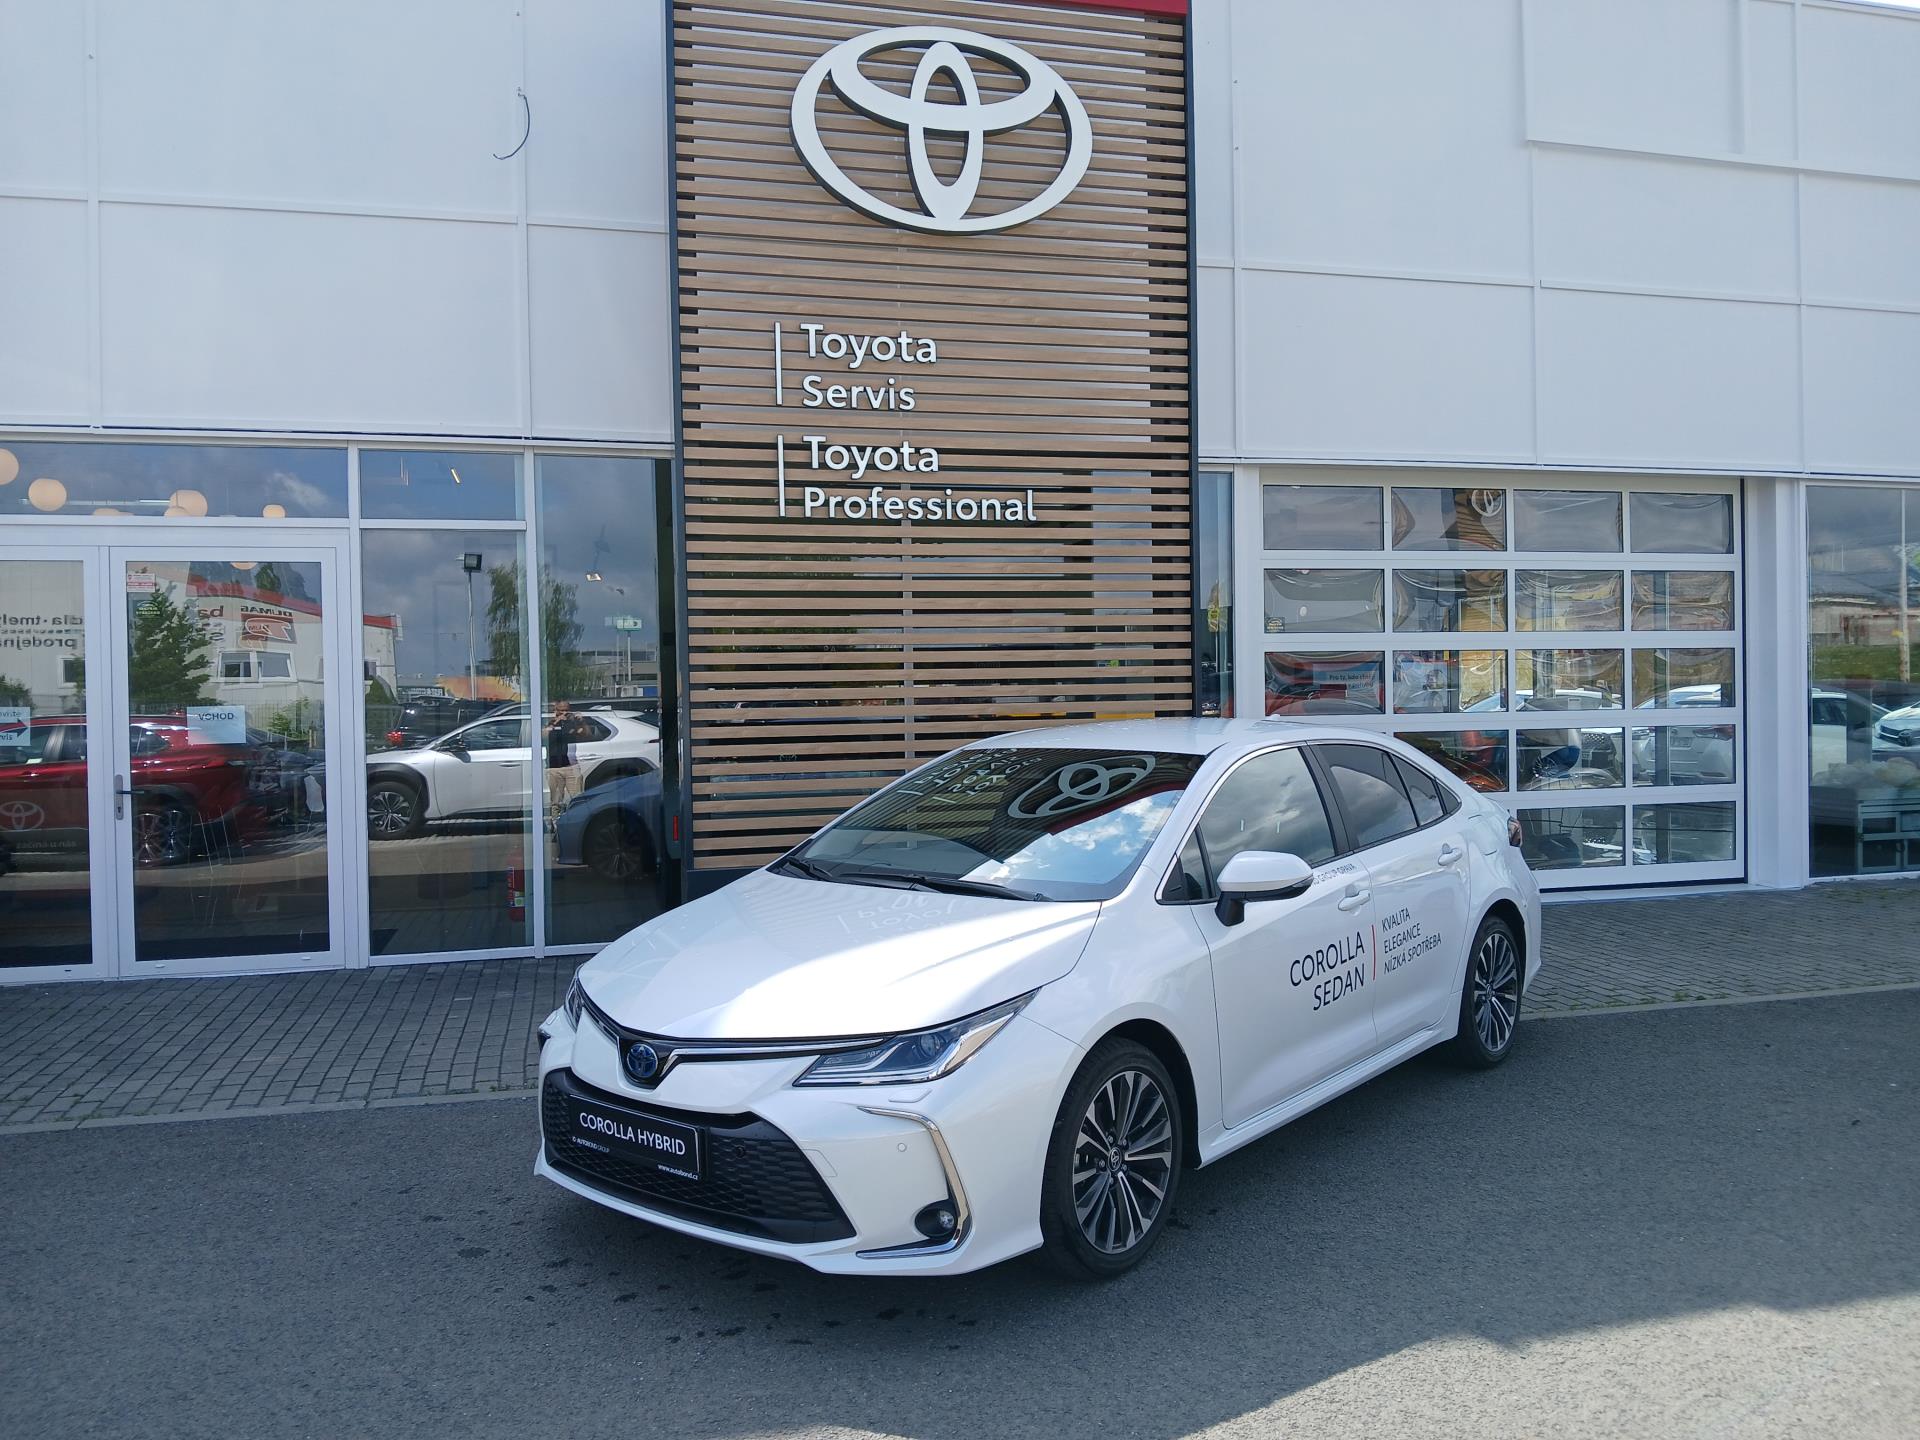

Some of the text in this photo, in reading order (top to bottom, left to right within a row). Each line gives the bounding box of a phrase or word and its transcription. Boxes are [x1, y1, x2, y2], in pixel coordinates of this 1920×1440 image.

[799, 322, 938, 370] Toyota
[801, 374, 917, 411] Servis
[802, 434, 940, 480] Toyota
[803, 486, 1037, 522] Professional
[198, 712, 234, 721] VCHOD
[1381, 907, 1411, 933] KVALITA
[1383, 922, 1421, 954] ELEGANCE
[1289, 931, 1365, 987] COROLLA
[1407, 932, 1442, 962] SPOTŘEBA
[1313, 963, 1365, 1011] SEDAN
[579, 1112, 686, 1156] COROLLA HYBRID
